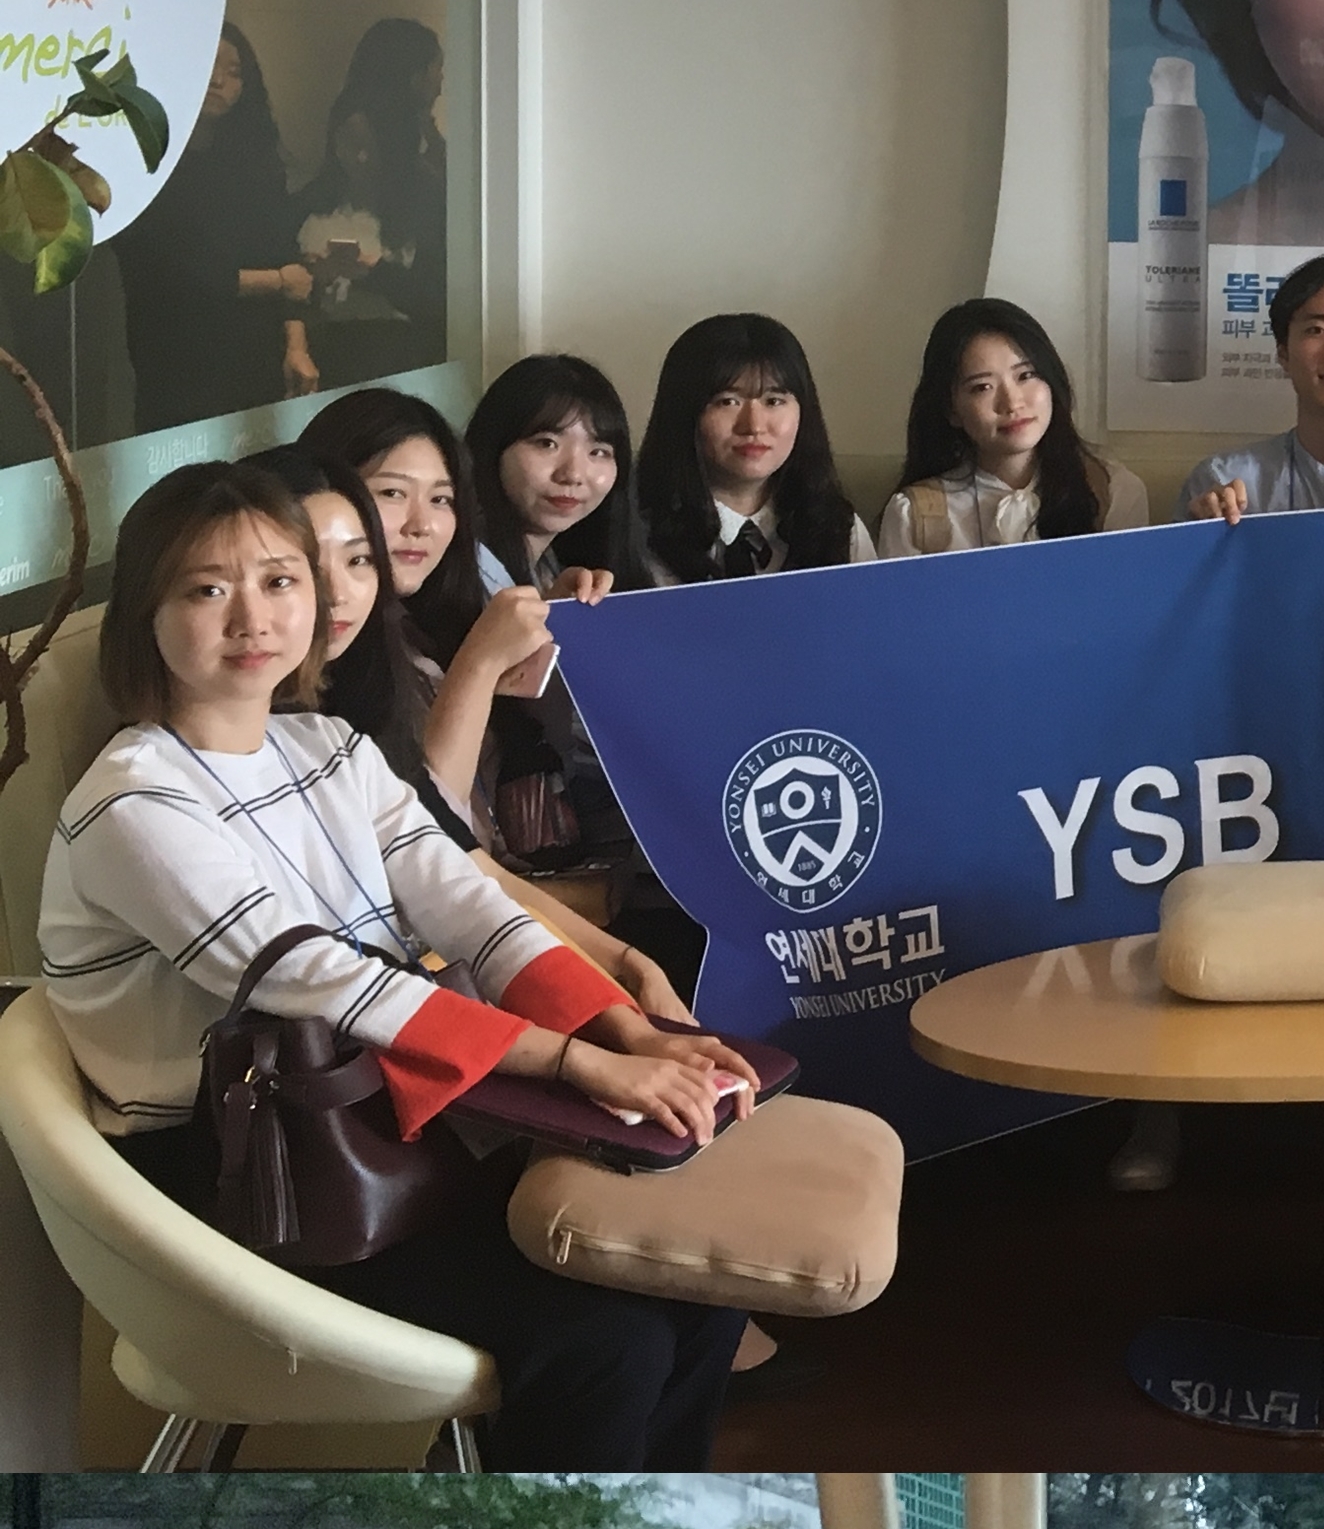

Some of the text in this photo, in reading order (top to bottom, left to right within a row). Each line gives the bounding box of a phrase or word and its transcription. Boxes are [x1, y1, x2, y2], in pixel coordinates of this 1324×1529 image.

[771, 736, 876, 808] UNIVERSITY
[1016, 754, 1282, 900] YSB
[764, 904, 946, 985] 연세대학교
